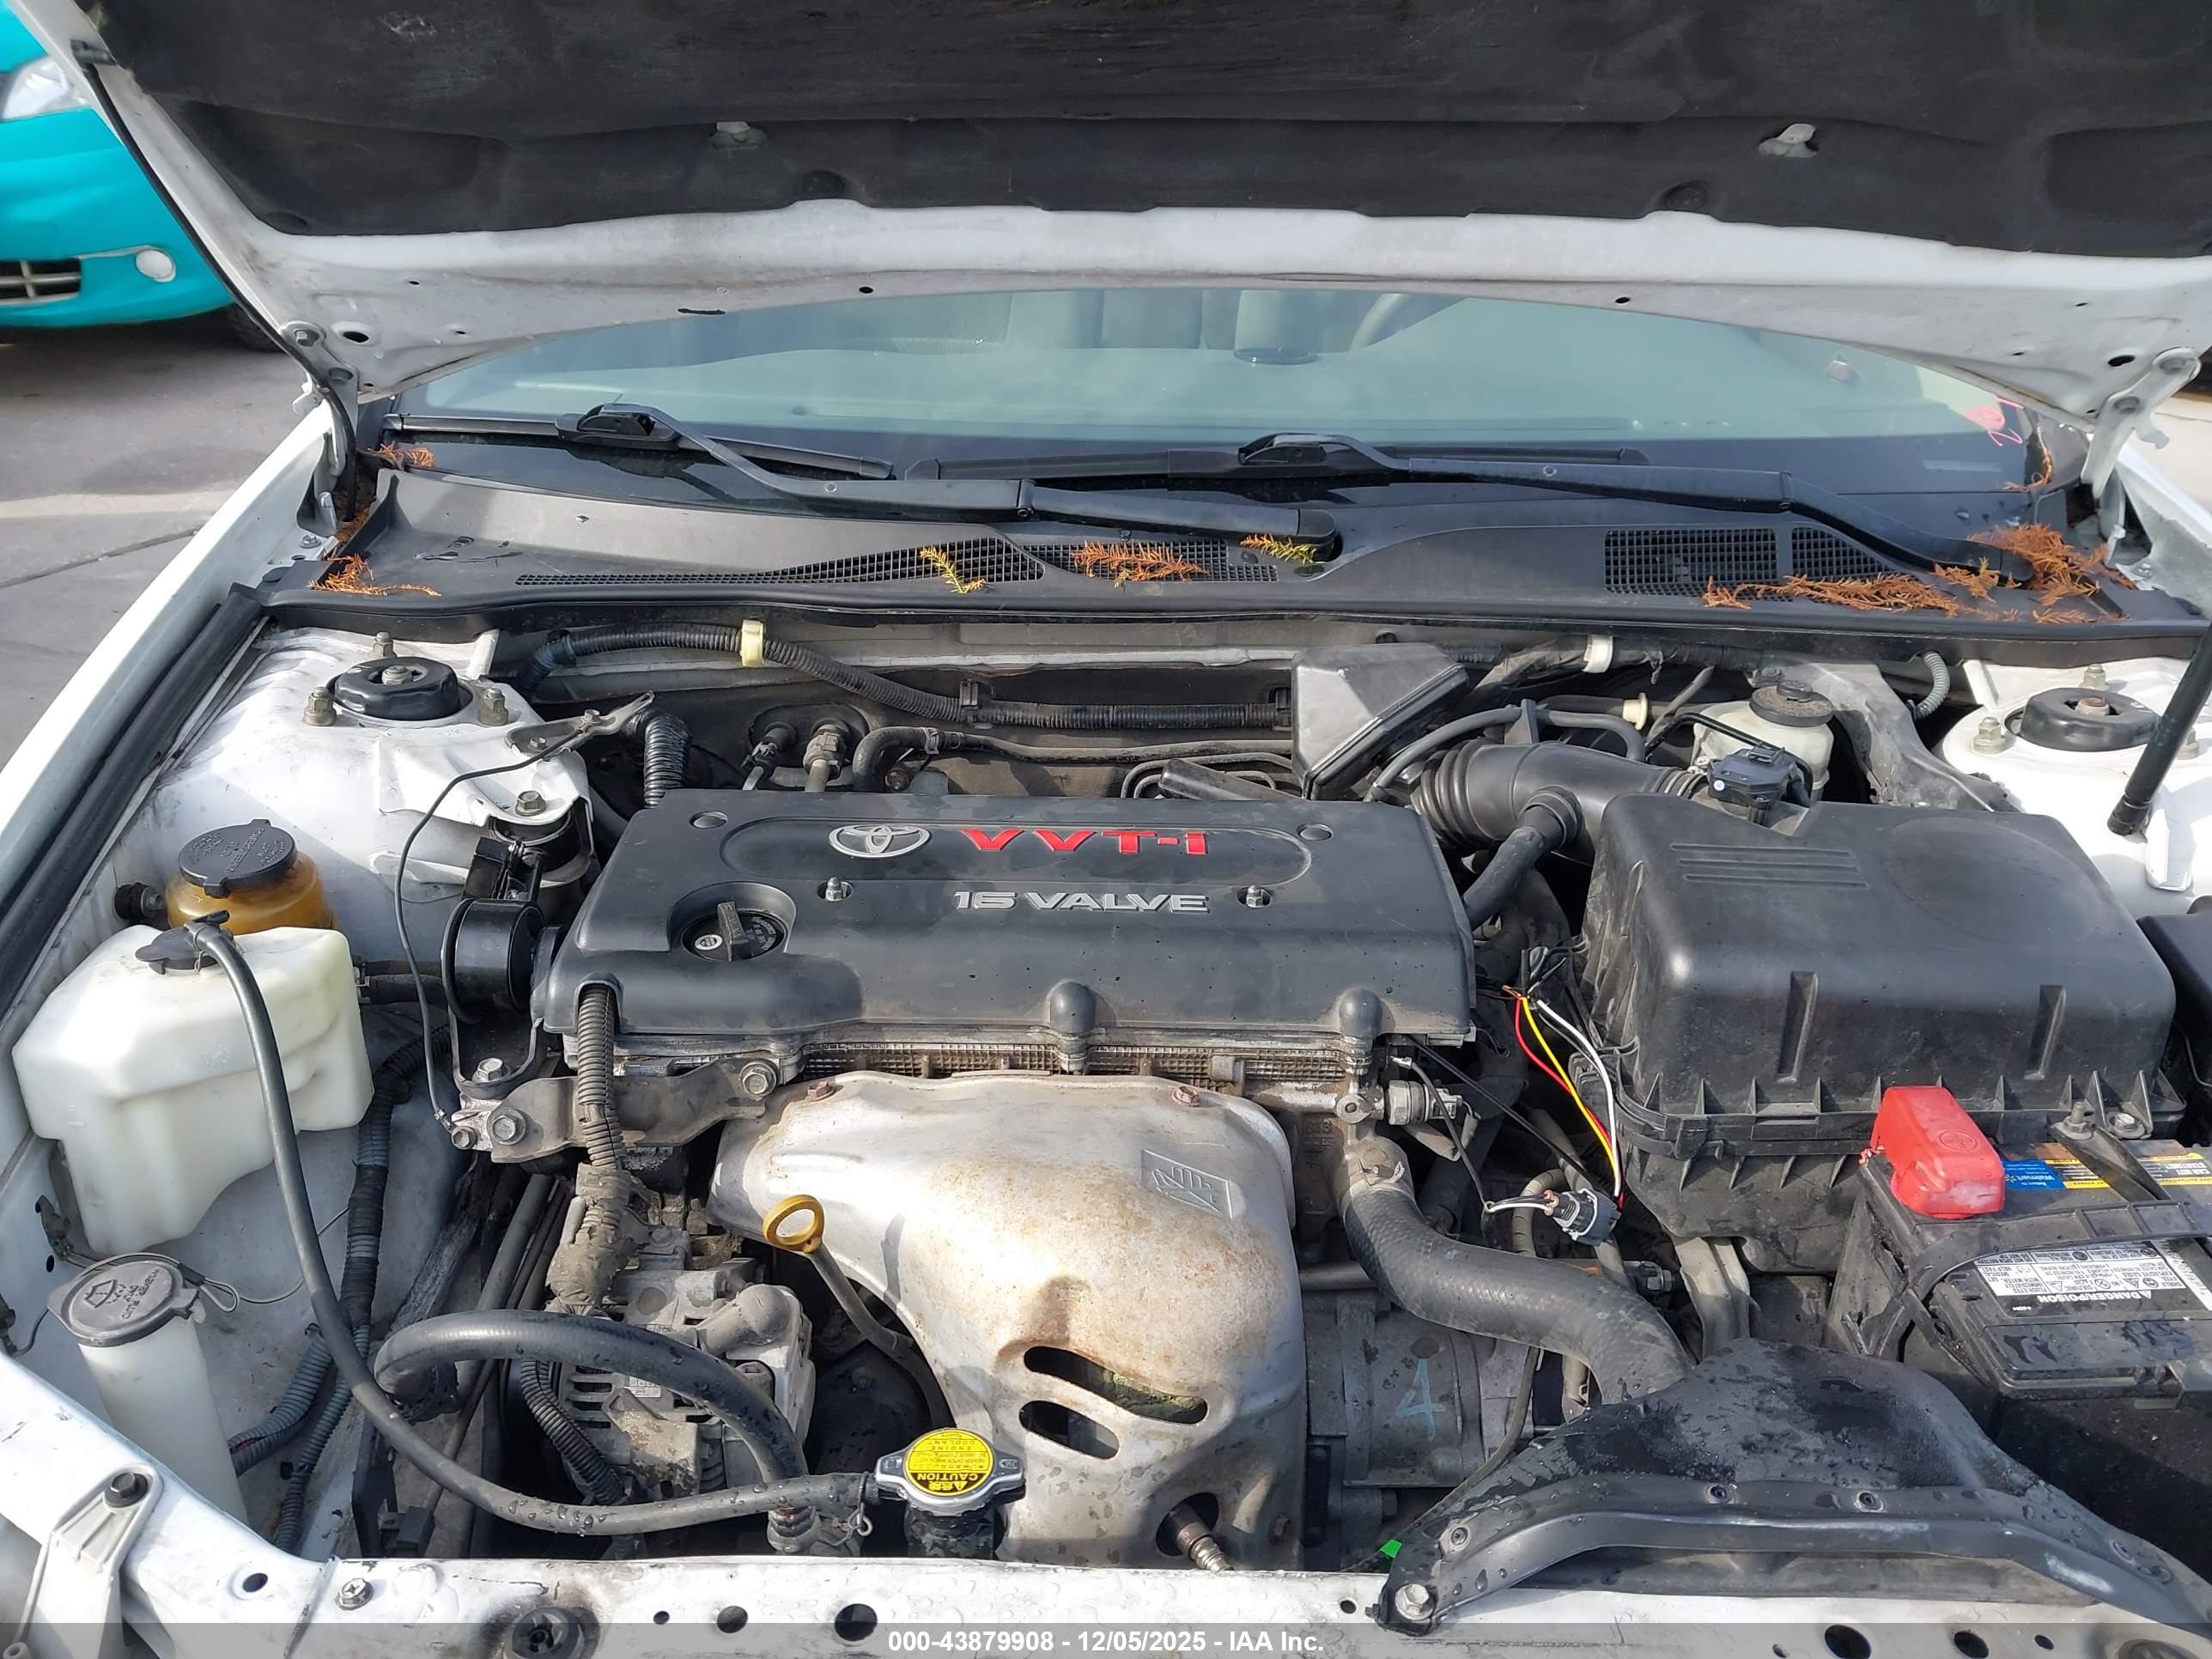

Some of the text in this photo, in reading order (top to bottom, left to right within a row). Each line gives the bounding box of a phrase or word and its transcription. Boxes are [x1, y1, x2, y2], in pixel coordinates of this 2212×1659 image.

[955, 890, 1211, 913] 16 VALVE
[2037, 1291, 2142, 1303] DANGER/POISON
